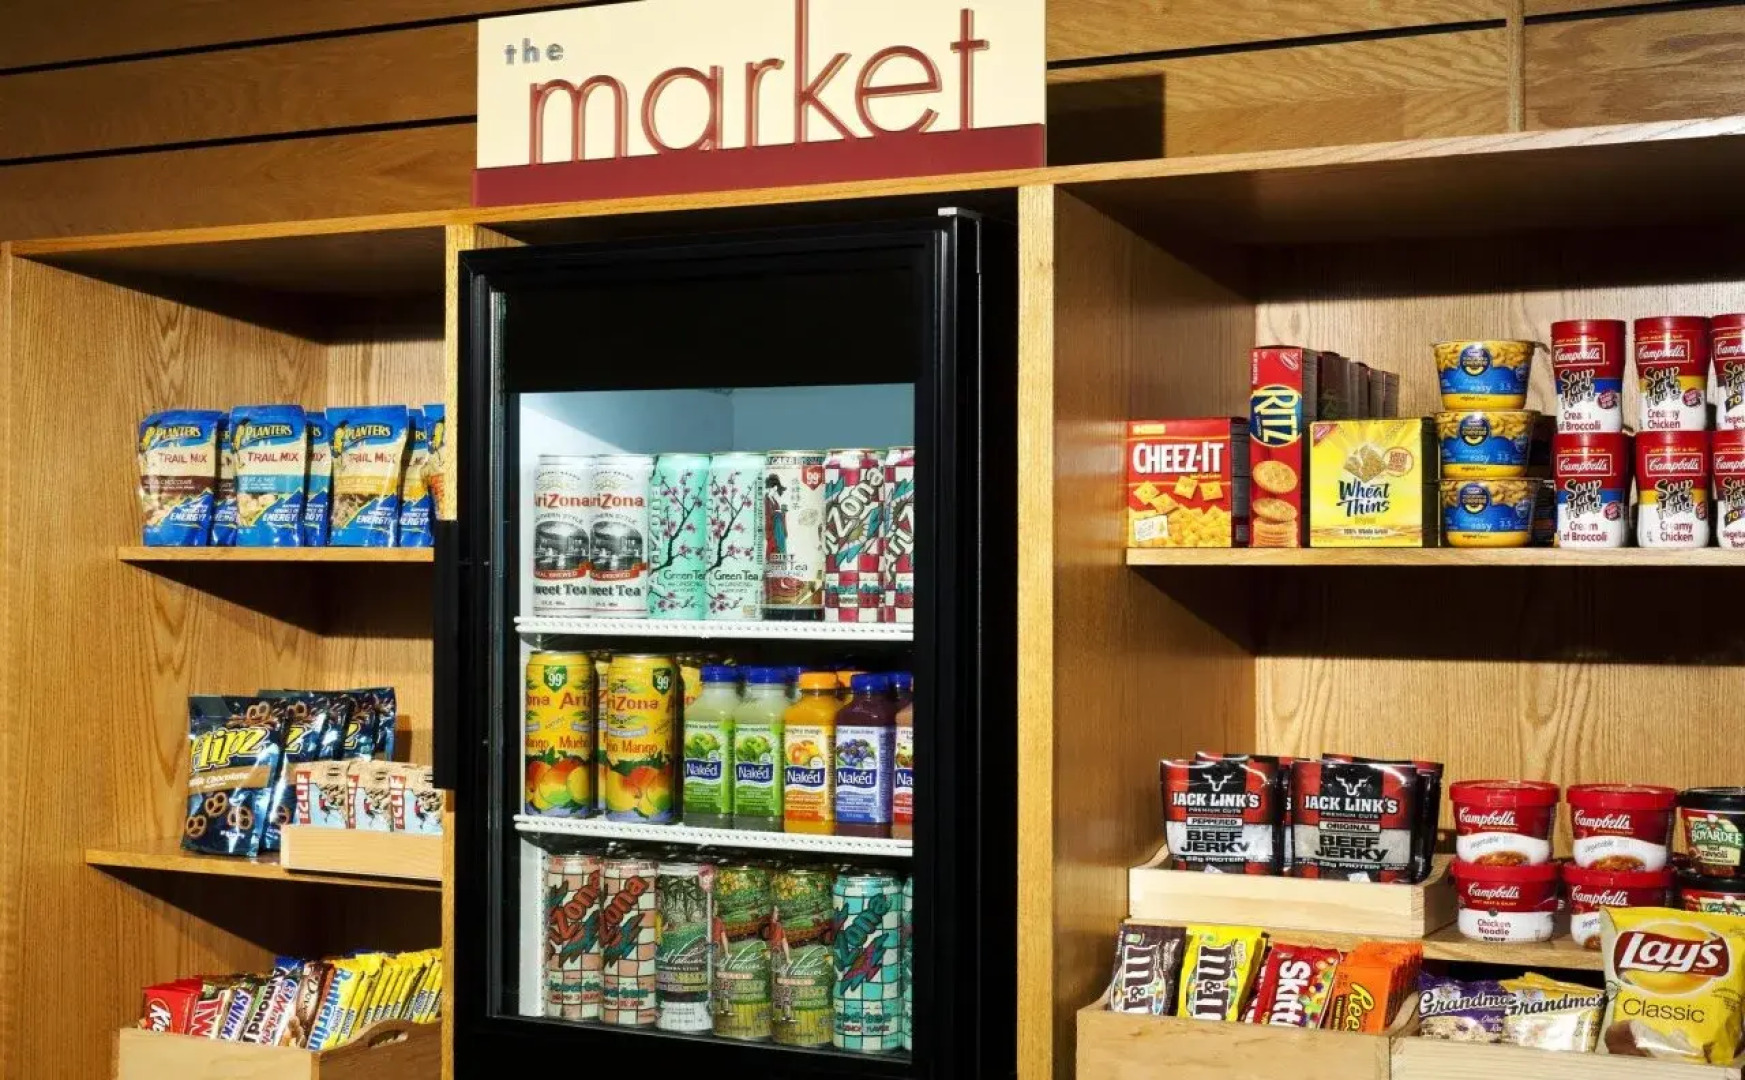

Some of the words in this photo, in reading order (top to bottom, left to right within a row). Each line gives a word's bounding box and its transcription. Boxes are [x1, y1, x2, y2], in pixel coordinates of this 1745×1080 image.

[504, 37, 564, 64] the
[529, 0, 990, 165] market
[1555, 347, 1600, 363] Campbell's
[1638, 345, 1685, 361] Campbell's
[1560, 368, 1596, 391] Soup
[1644, 366, 1680, 388] Soup
[1254, 389, 1299, 443] RITZ
[1647, 419, 1681, 429] Chicken
[155, 425, 202, 441] PLANTERS
[245, 424, 293, 440] PLANTERS
[344, 424, 391, 439] PLANTERS
[1566, 420, 1602, 431] Broccoli
[158, 452, 188, 463] TRAIL
[190, 452, 208, 463] MIX
[247, 452, 278, 462] TRAIL
[280, 452, 299, 462] MIX
[1132, 441, 1224, 474] CHEEZ-IT
[1560, 458, 1608, 473] Campbell's
[1649, 458, 1700, 473] Campbell's
[1338, 478, 1390, 500] Wheat
[1565, 479, 1603, 500] Soup
[1655, 479, 1694, 500] Soup
[1336, 499, 1391, 518] Thins
[1569, 521, 1598, 531] Crem
[1660, 521, 1693, 533] Camy
[1571, 532, 1608, 541] Broccoli
[1660, 532, 1694, 542] Chicken
[789, 562, 808, 571] Tea
[663, 569, 691, 581] Green
[713, 570, 743, 581] Green
[743, 570, 758, 580] Tea
[562, 584, 588, 597] Tea
[614, 585, 642, 597] Tea
[622, 739, 658, 754] Mango
[296, 773, 309, 813] CLIF
[390, 777, 405, 818] CLIF
[1173, 791, 1207, 806] JACK
[1209, 793, 1260, 808] LINK'S
[1305, 795, 1341, 811] JACK
[1344, 798, 1399, 814] LINK'S
[1459, 807, 1517, 828] Campbell's
[1574, 810, 1632, 831] Campbell's
[1326, 823, 1372, 831] ORIGINAL
[1187, 830, 1242, 841] BEEF
[1320, 835, 1380, 848] BEEF
[1691, 828, 1743, 846] BOYARDEE
[1181, 842, 1250, 853] JERKY
[1314, 847, 1389, 862] JERKY
[1339, 862, 1381, 870] PROTEIN
[1467, 882, 1520, 899] Campbell's
[1571, 885, 1629, 906] Campbell's
[1478, 926, 1510, 936] Noodle
[1618, 931, 1724, 973] Lay's
[248, 966, 290, 1036] Almond
[1623, 997, 1705, 1024] Classic
